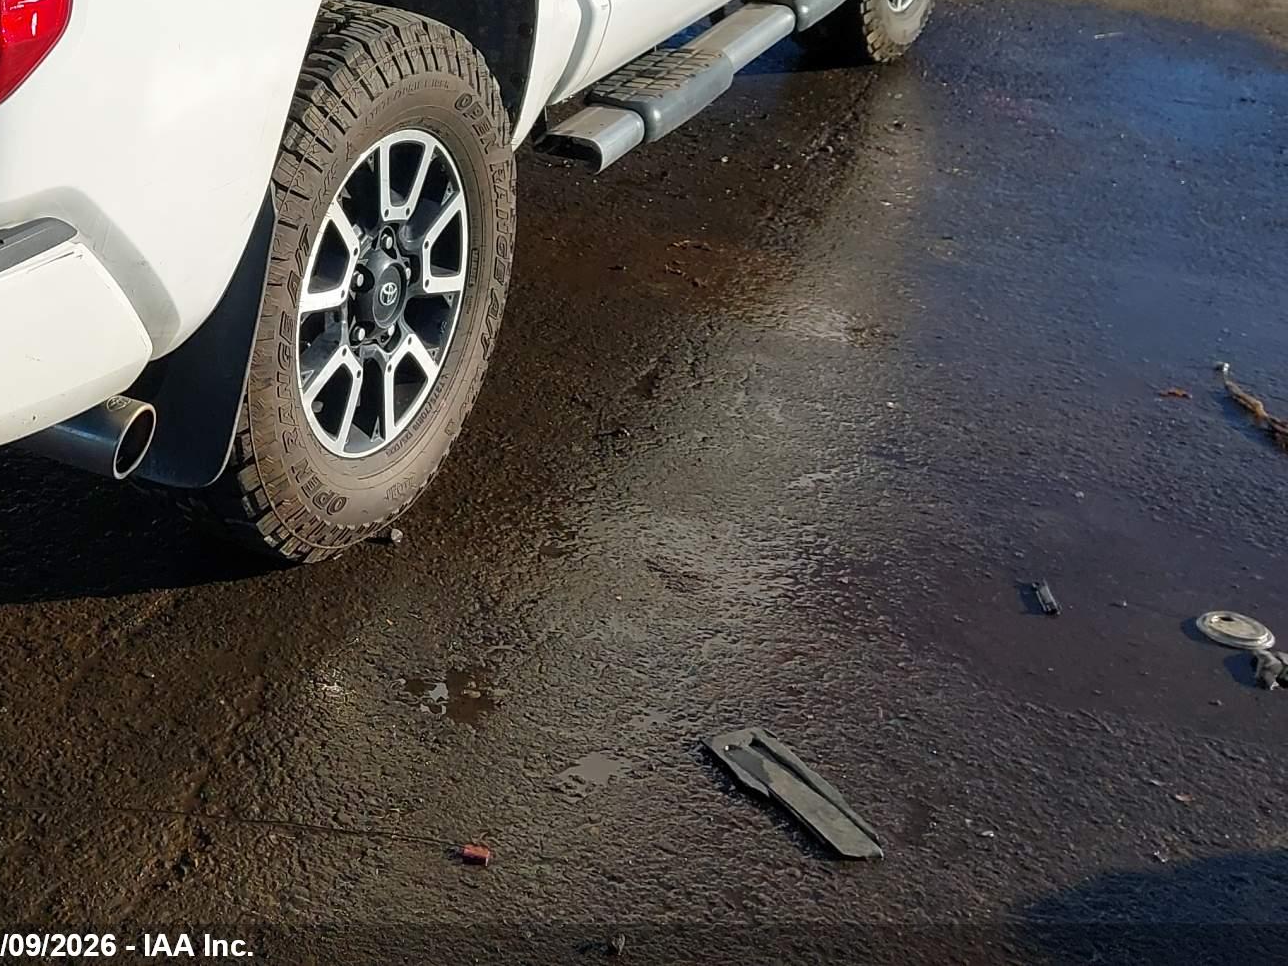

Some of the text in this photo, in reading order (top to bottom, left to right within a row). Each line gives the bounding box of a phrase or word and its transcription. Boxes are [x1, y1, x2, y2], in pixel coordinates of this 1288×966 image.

[489, 163, 509, 286] RANGE
[276, 309, 305, 454] RANGE
[290, 457, 348, 517] OPEN
